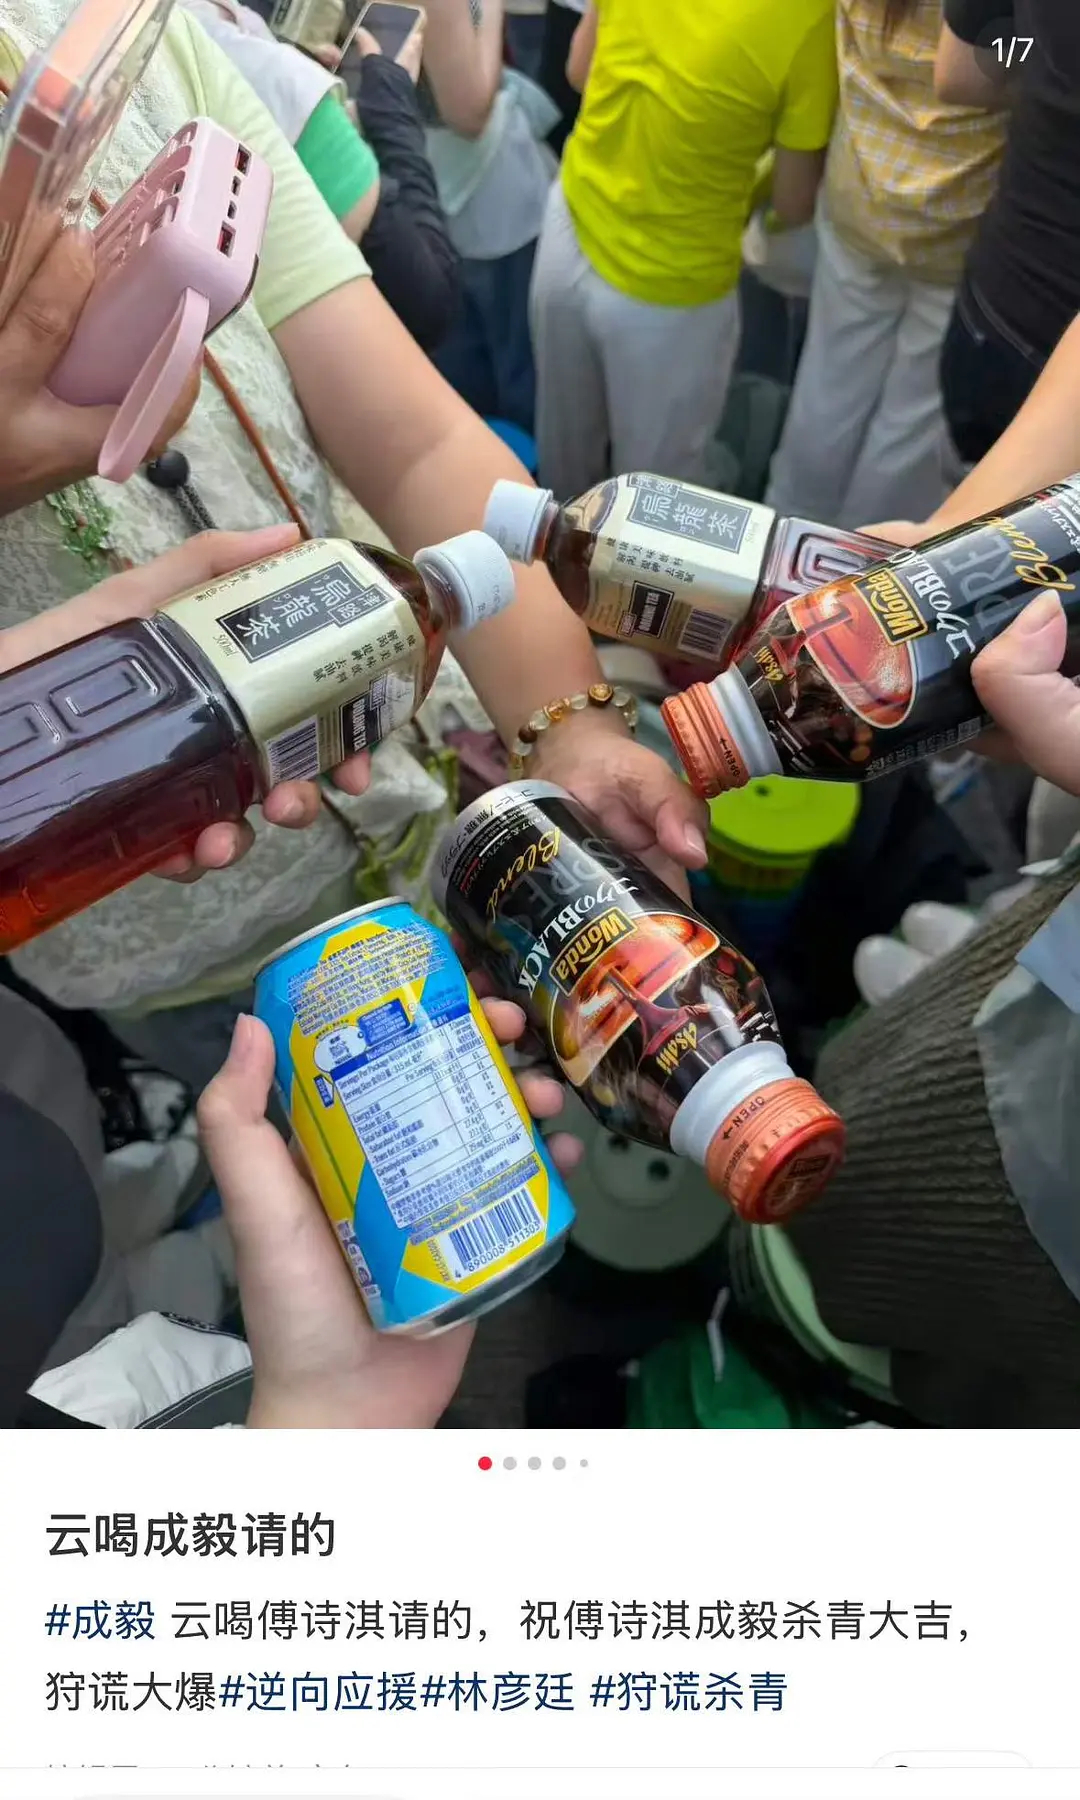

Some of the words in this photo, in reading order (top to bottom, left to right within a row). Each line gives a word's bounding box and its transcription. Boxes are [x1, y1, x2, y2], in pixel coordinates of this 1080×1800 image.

[640, 491, 738, 538] 烏龍茶
[236, 577, 350, 645] 烏龍茶
[866, 569, 921, 637] Wonda
[754, 645, 785, 682] Asahi
[724, 750, 741, 778] OPEN
[487, 826, 561, 924] Blend
[555, 912, 628, 981] Wonda
[656, 1021, 698, 1076] Asahi
[732, 1096, 765, 1128] OPEN
[467, 1244, 507, 1273] 890008
[507, 1220, 543, 1252] 511303
